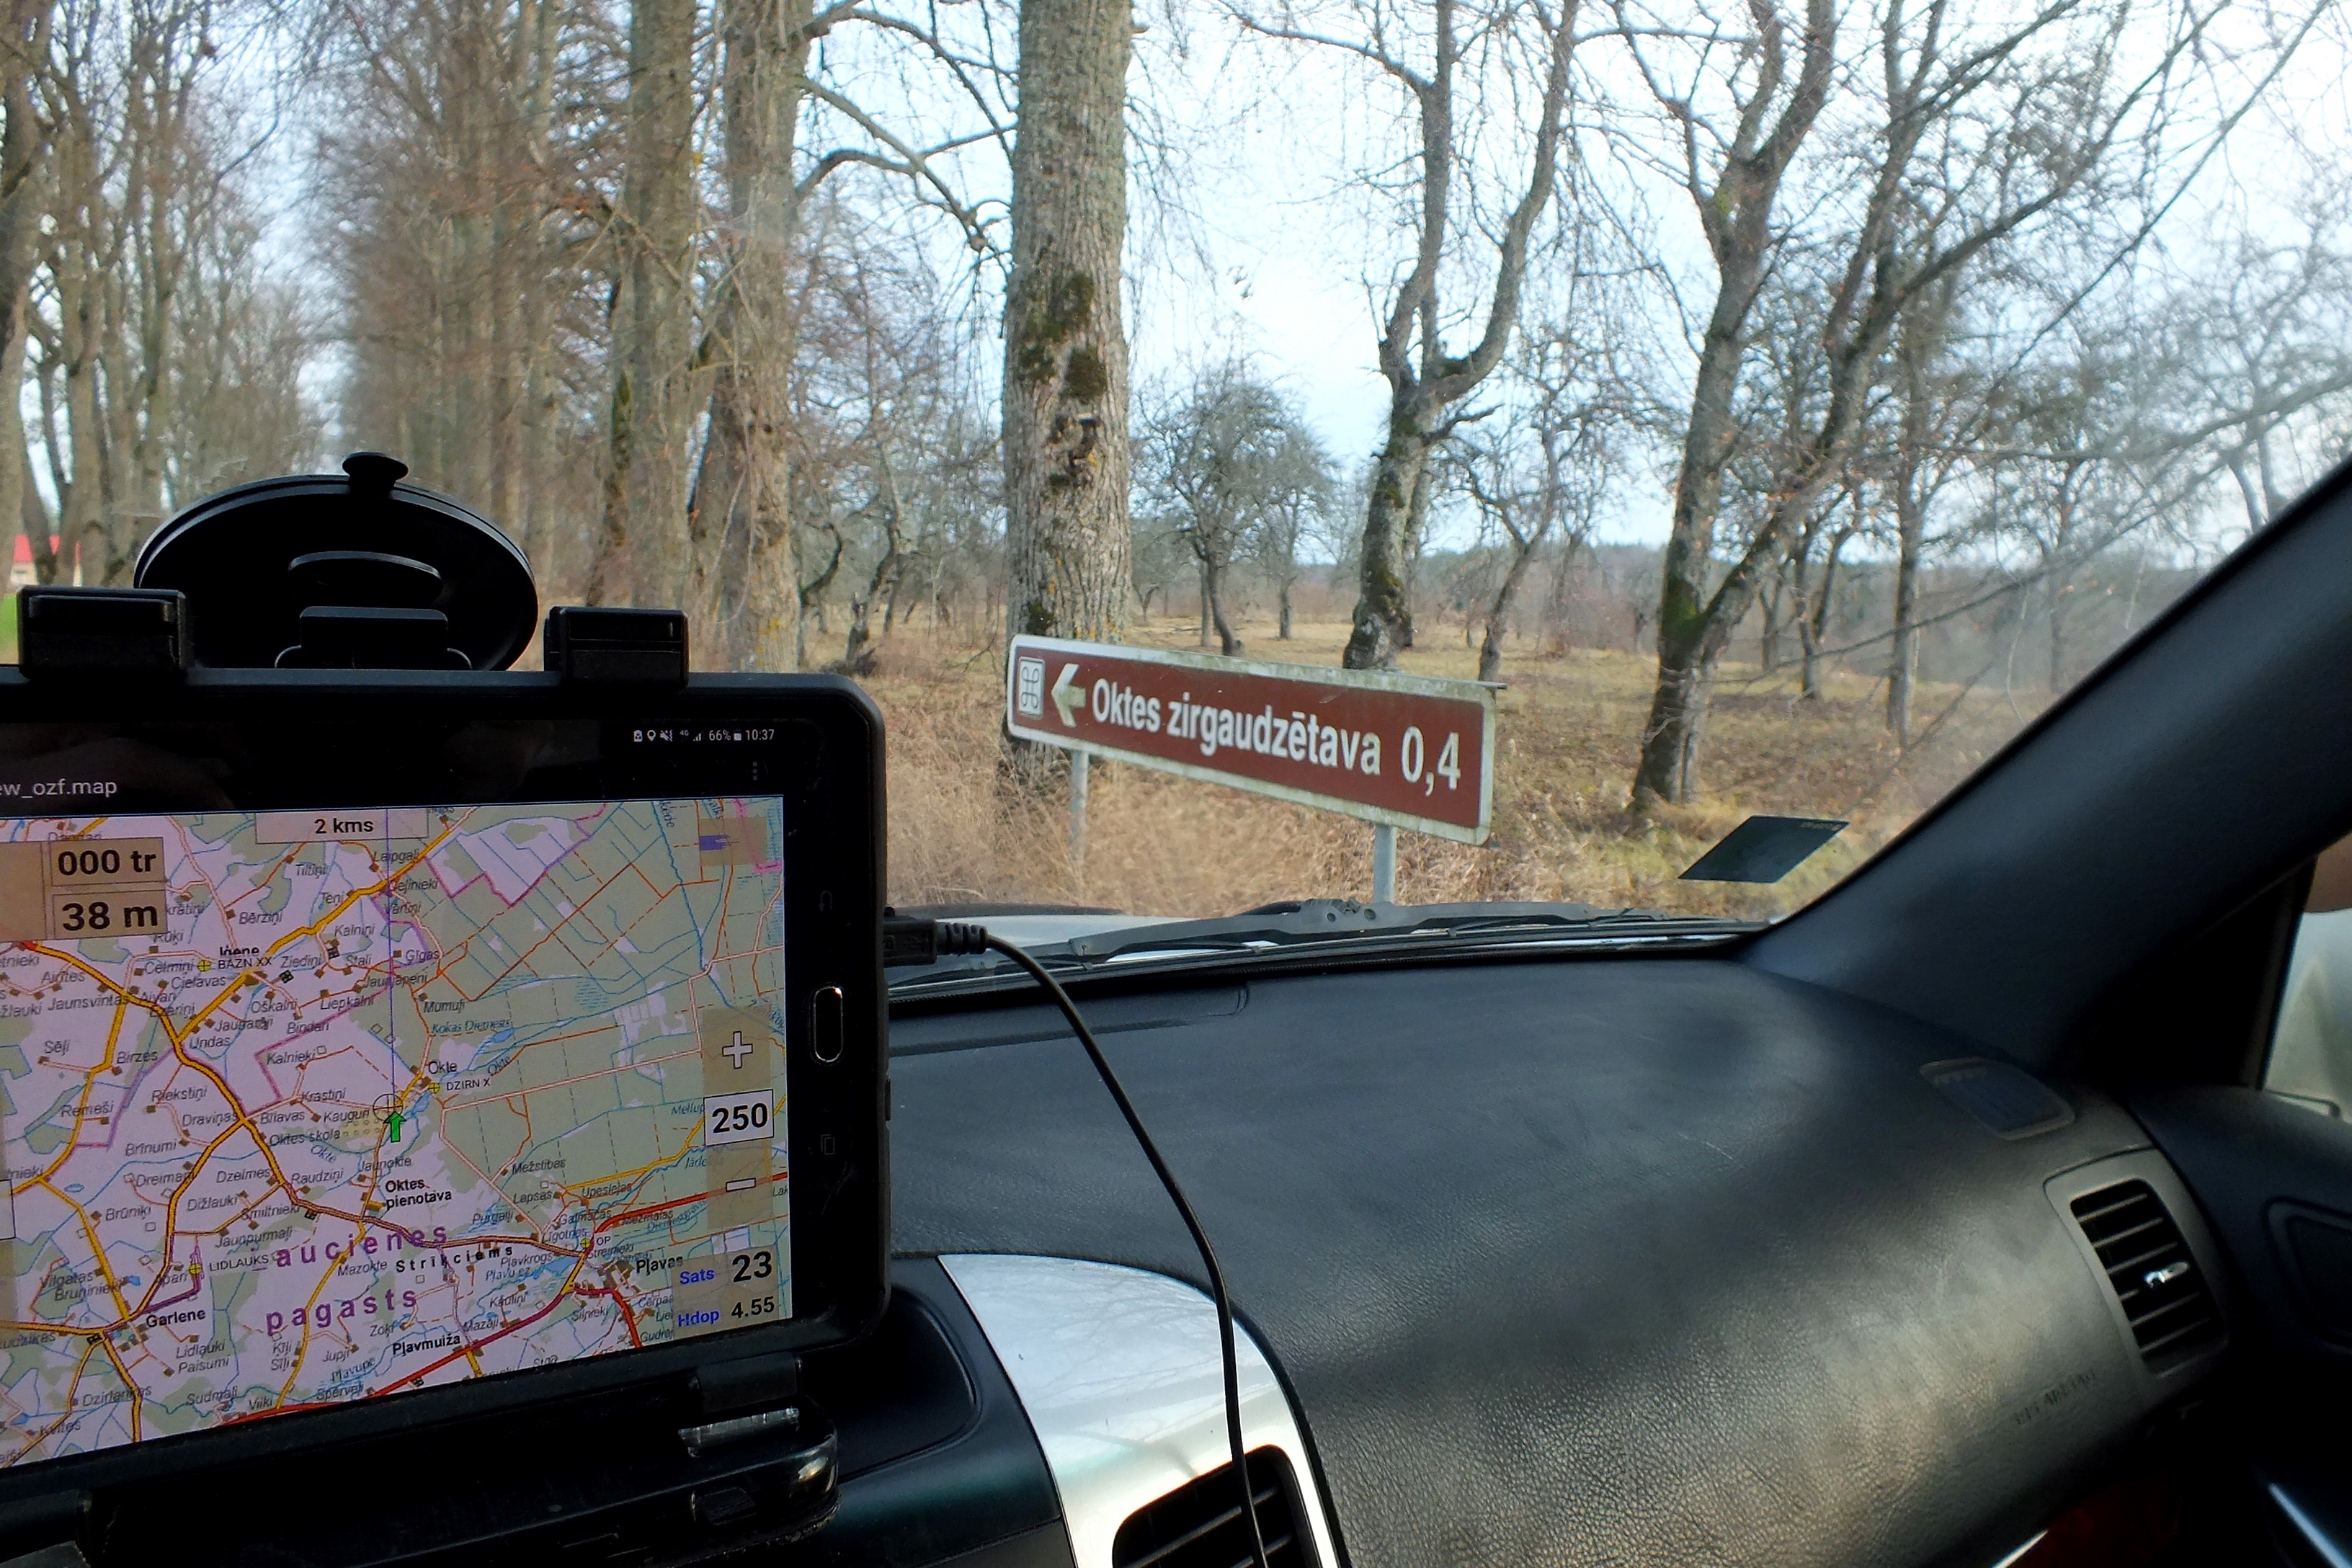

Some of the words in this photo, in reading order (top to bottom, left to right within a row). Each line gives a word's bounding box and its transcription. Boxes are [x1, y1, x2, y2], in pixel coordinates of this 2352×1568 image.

[708, 729, 731, 741] 66%
[745, 729, 775, 741] 10:37
[1092, 678, 1162, 733] Oktes
[1167, 691, 1381, 776] zirgaudzētava
[1401, 726, 1461, 796] 0,4
[314, 819, 327, 834] 2
[333, 817, 374, 833] kms
[58, 850, 121, 876] 000
[130, 850, 156, 873] tr
[62, 901, 111, 932] 38
[123, 905, 159, 928] m
[427, 1060, 458, 1074] Okte
[711, 1102, 769, 1133] 250
[384, 1177, 425, 1193] Oktes
[596, 1235, 612, 1246] OP
[731, 1250, 773, 1283] 23
[679, 1268, 716, 1286] Sats
[731, 1296, 775, 1319] 4.55
[146, 1309, 207, 1328] Garlene
[677, 1308, 721, 1328] Hdop
[392, 1333, 461, 1357] Pļavmuiža
